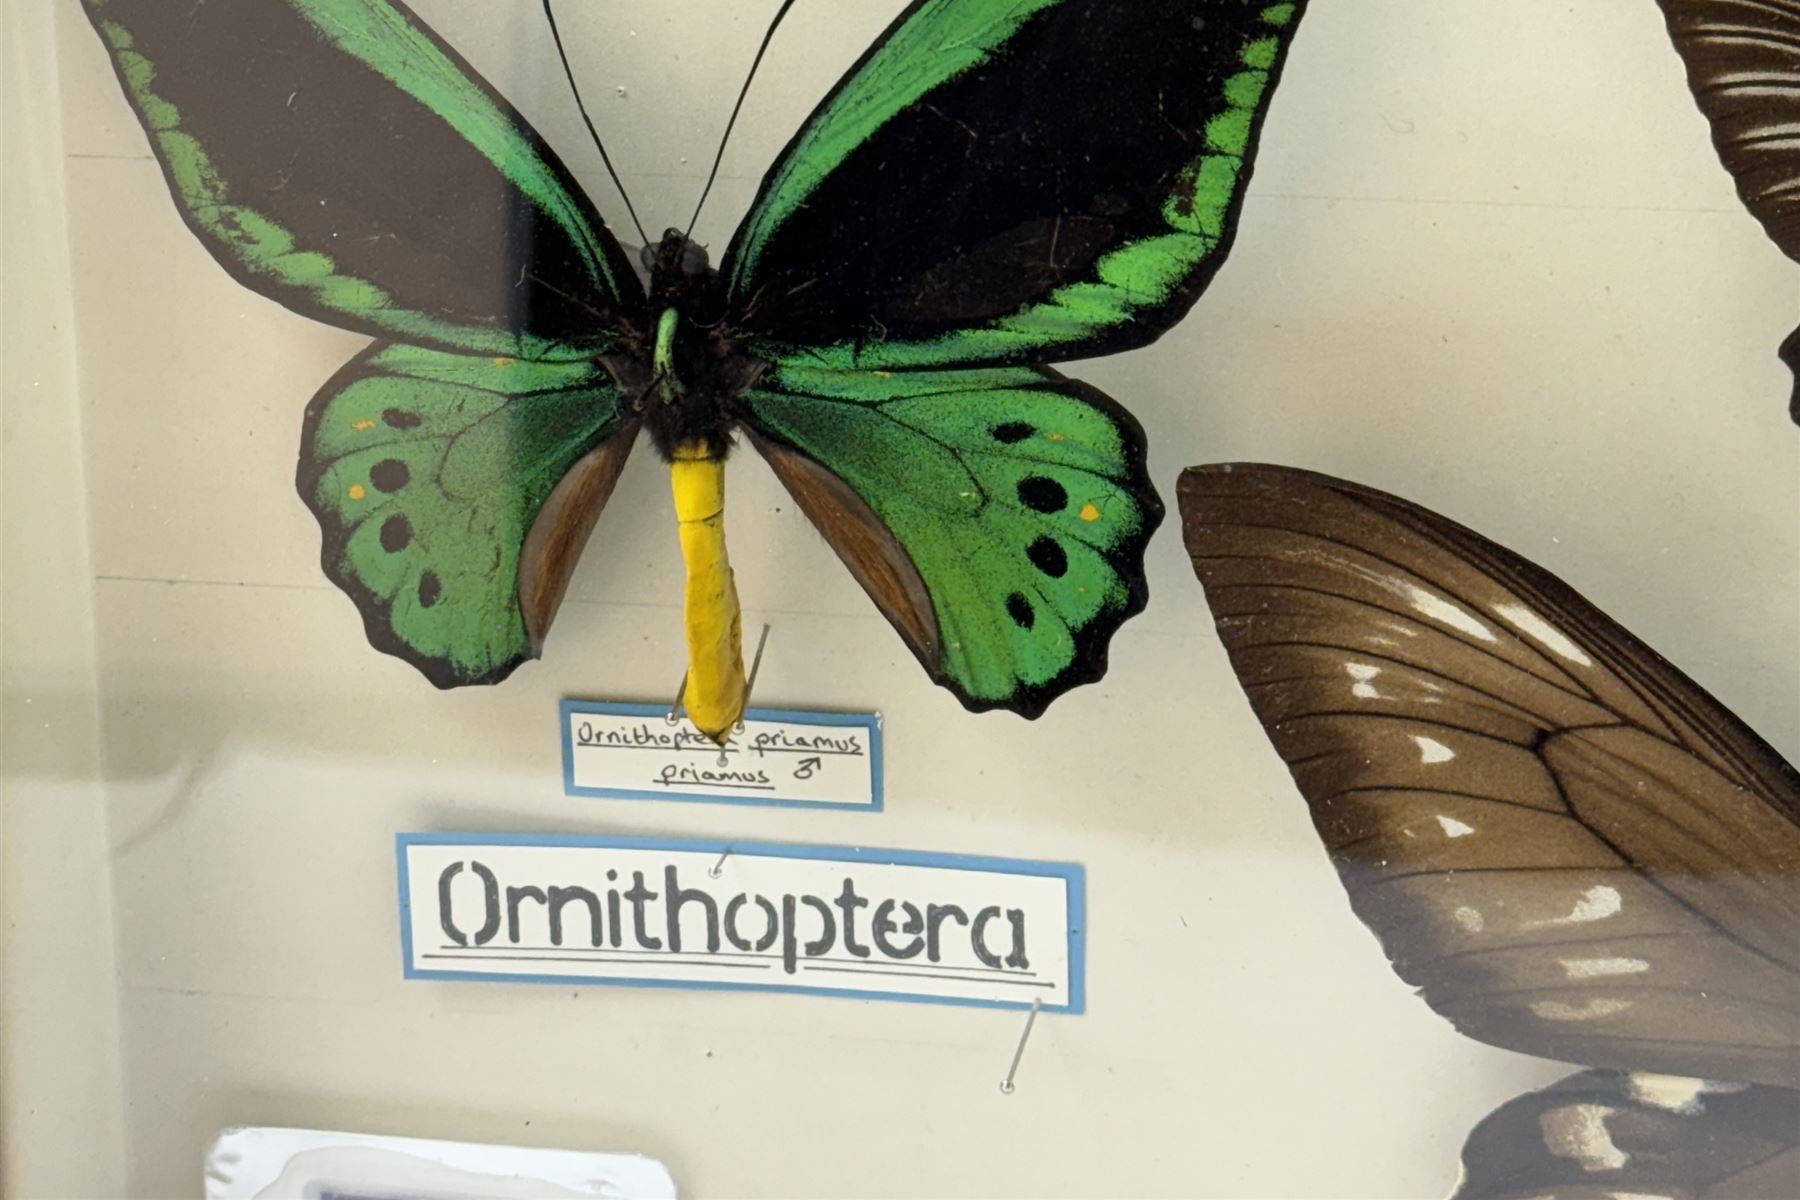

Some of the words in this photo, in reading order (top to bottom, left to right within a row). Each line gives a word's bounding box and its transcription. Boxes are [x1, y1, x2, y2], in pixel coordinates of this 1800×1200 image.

[754, 732, 862, 756] priamus
[660, 763, 770, 786] priamus
[438, 860, 1031, 974] Ornithoptera
